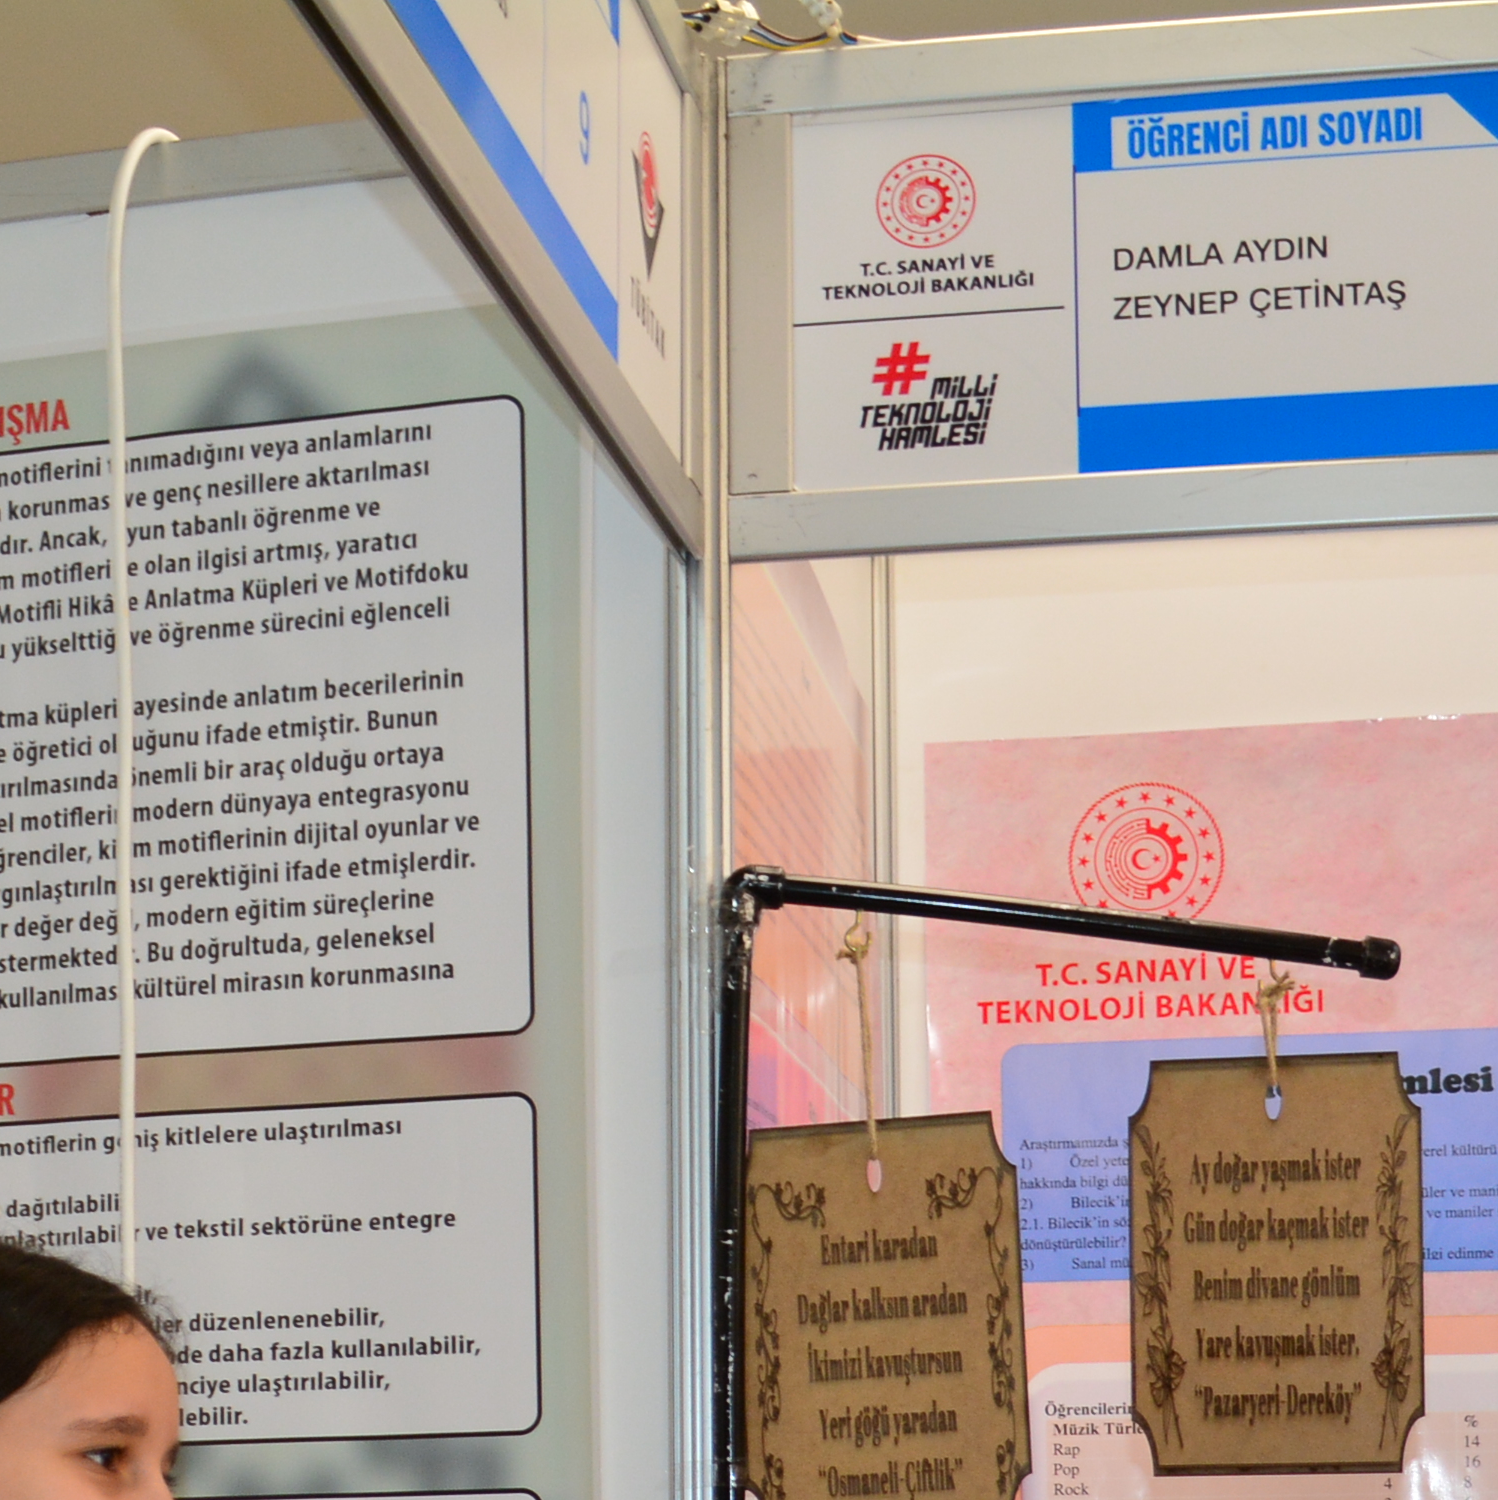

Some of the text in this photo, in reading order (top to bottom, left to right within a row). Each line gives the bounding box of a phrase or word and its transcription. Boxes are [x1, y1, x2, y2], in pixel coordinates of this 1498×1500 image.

[1128, 107, 1422, 159] ÖĞRENCİ ADI SOYADI
[860, 254, 994, 276] T.C. SANAYİ VE
[1114, 236, 1327, 271] DAMLA AYDIN
[822, 271, 1033, 300] TEKNOLOJİ BAKANLIĞI
[1114, 279, 1406, 320] ZEYNEP ÇETİNTAŞ
[1035, 953, 1256, 986] T.C. SANAYİ VE
[977, 984, 1324, 1024] TEKNOLOJİ BAKANIĞI
[1190, 1148, 1361, 1195] Ay doğar yaşmak ister
[821, 1226, 938, 1266] Entari karadan
[1184, 1206, 1369, 1252] Gün doğar kaçmak ister
[1194, 1264, 1360, 1309] Benim divane gönlüm
[797, 1282, 968, 1335] Dağlar kalksın aradan
[808, 1342, 963, 1386] İkimizi kavuştursun
[1196, 1324, 1359, 1367] Yare kavuşmak ister.
[819, 1400, 957, 1448] Yeri göğü yaradan
